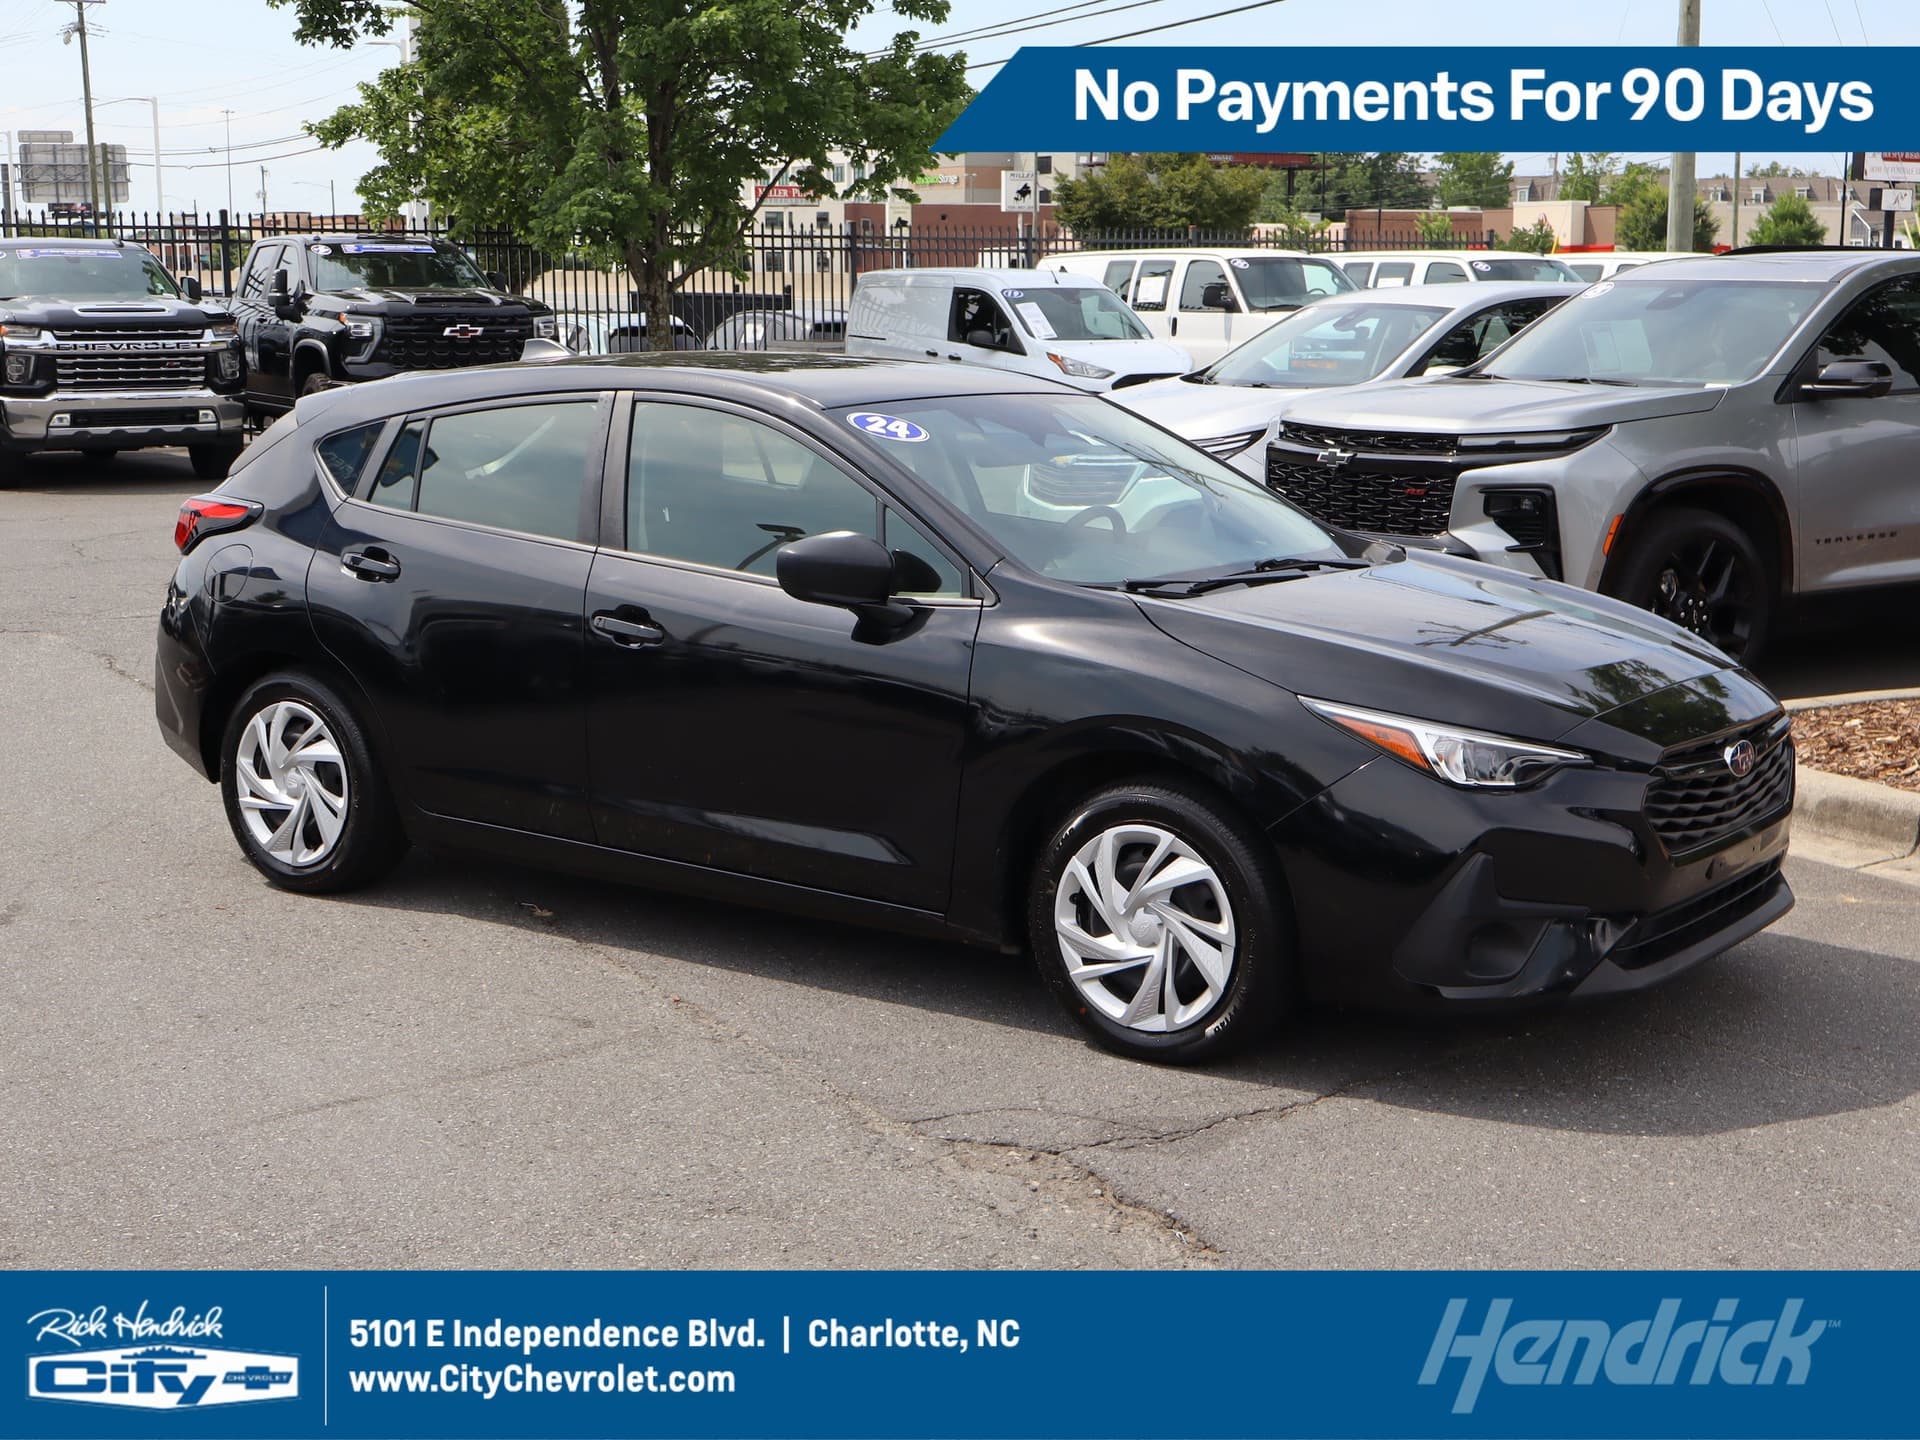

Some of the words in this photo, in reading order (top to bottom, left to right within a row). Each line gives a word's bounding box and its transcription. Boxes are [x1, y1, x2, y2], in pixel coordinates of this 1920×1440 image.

[758, 188, 788, 197] MLLER
[56, 341, 202, 350] CHEVROLET
[865, 416, 910, 438] 24
